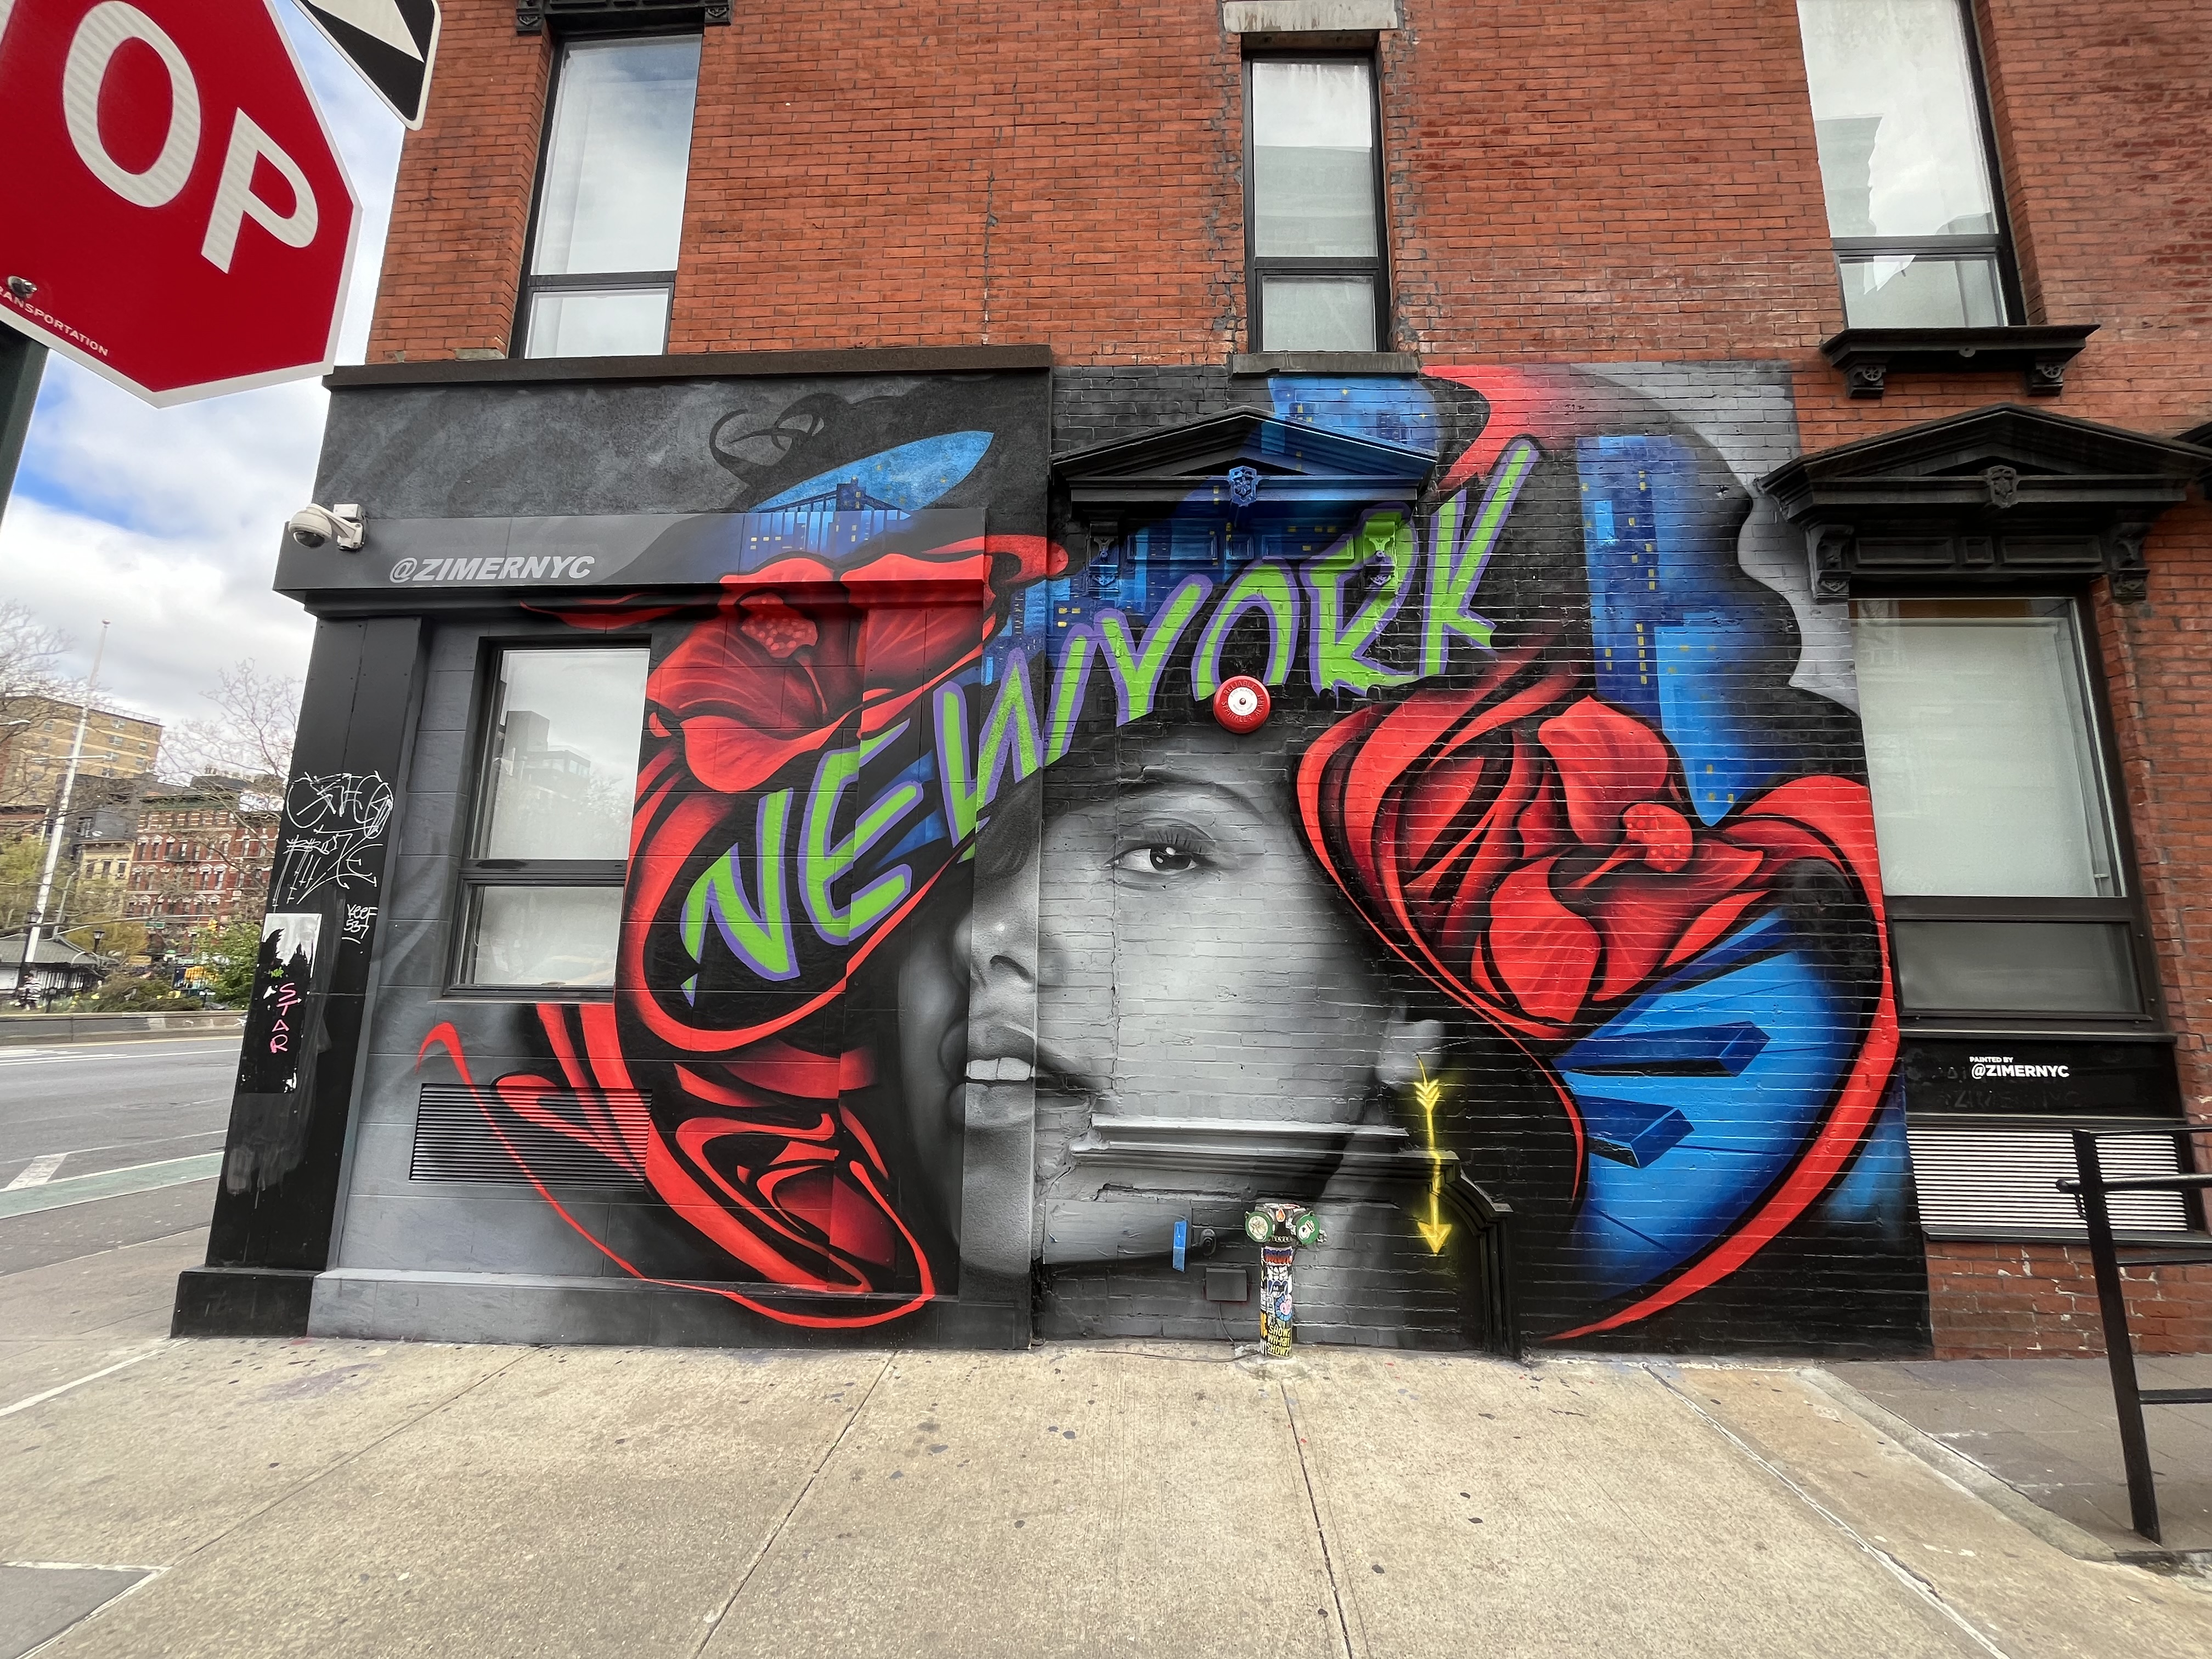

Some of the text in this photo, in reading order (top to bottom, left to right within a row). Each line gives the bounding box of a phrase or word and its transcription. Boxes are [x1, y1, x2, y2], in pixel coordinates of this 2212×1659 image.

[0, 0, 319, 274] OP
[390, 556, 595, 584] @ZIMERNYC
[1223, 680, 1257, 696] RELIABLE
[680, 437, 1541, 1007] NEW YORK
[1221, 701, 1253, 723] SPRINKLER
[343, 918, 370, 939] 537
[269, 983, 302, 1054] STAR
[1972, 1063, 2070, 1079] @ZIMERNYC
